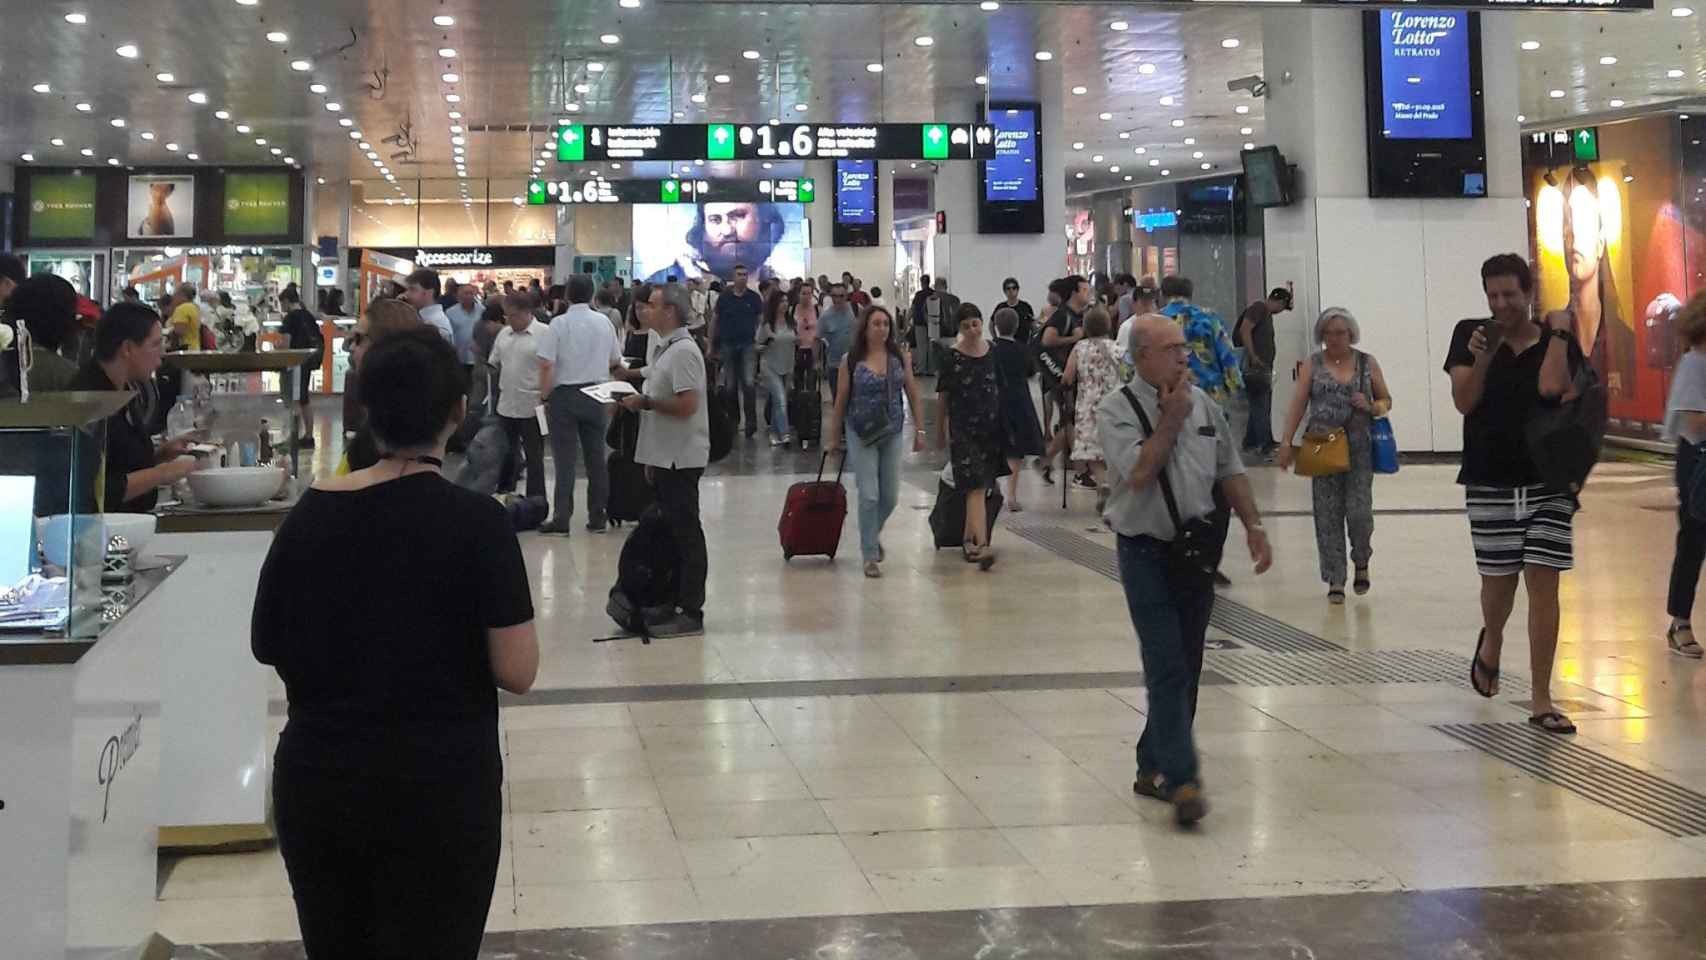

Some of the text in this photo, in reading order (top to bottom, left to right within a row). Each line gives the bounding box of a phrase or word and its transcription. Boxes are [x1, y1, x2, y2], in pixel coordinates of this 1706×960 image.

[1391, 11, 1456, 29] Lorenzo
[1391, 28, 1437, 45] Lotto
[1394, 48, 1441, 57] RETRATOS
[757, 125, 813, 156] 1.6
[558, 181, 598, 203] 1.6
[415, 248, 493, 267] Accessorize
